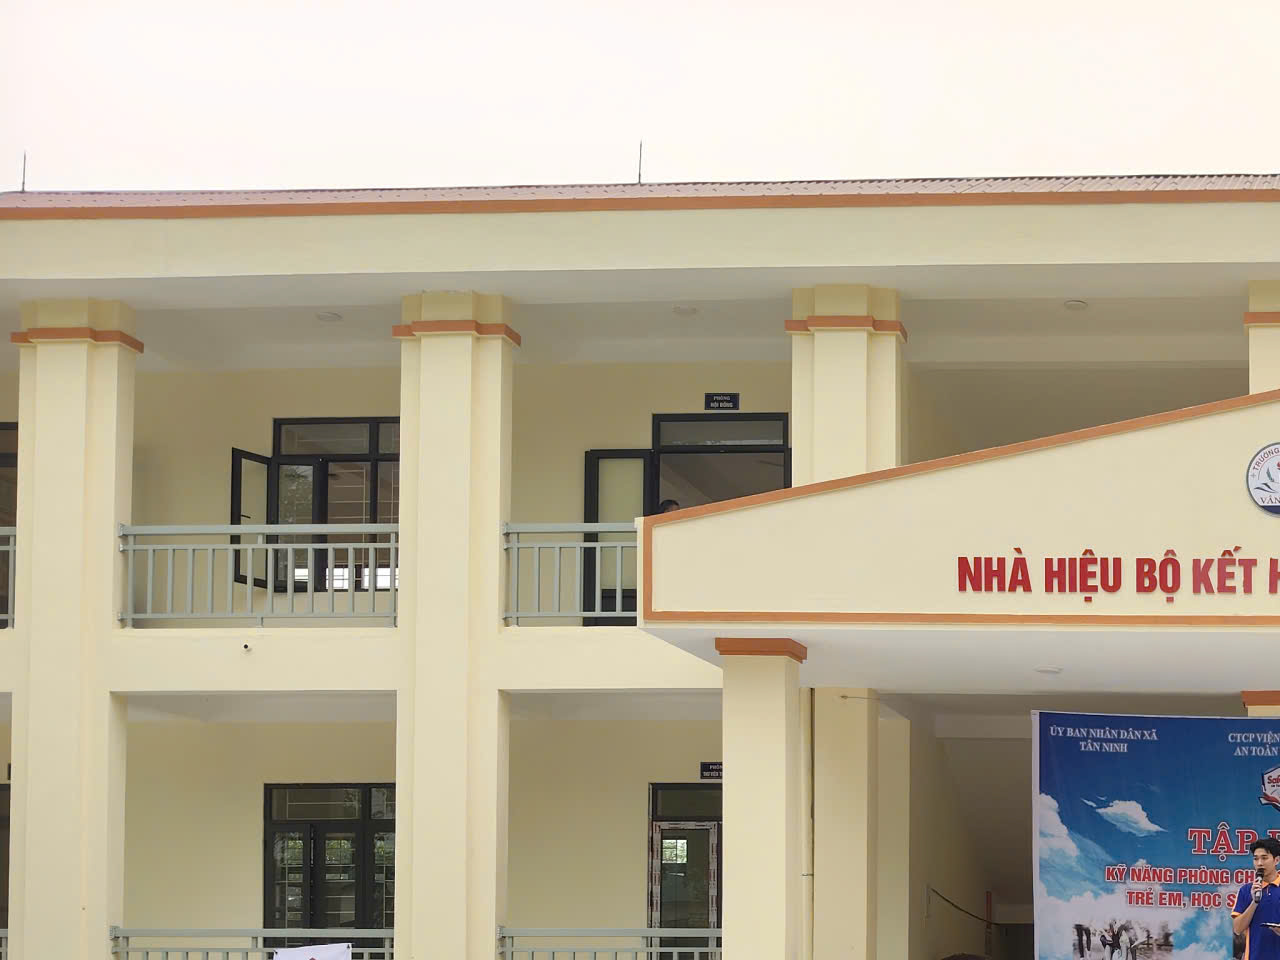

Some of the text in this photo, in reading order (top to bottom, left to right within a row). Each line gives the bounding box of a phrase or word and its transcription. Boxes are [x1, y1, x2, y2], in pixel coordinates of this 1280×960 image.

[957, 548, 1032, 593] NHÀ
[1044, 549, 1122, 602] HIỆU
[1135, 549, 1181, 602] BỘ
[1192, 546, 1258, 594] KẾT
[1049, 725, 1159, 740] ỦY BAN NHÂN DÂN XÃ
[1228, 733, 1255, 743] CTCP
[1256, 731, 1280, 745] VIỆN
[1080, 739, 1129, 753] TÂN NINH
[1233, 746, 1250, 756] AN
[1250, 744, 1279, 756] TOÀN
[1188, 822, 1259, 861] TẬP
[1105, 864, 1126, 882] KỸ
[1130, 864, 1174, 884] NĂNG
[1178, 866, 1230, 884] PHÒNG
[1126, 887, 1154, 906] TRẺ
[1158, 891, 1187, 908] EM,
[1191, 892, 1222, 911] HỌC
